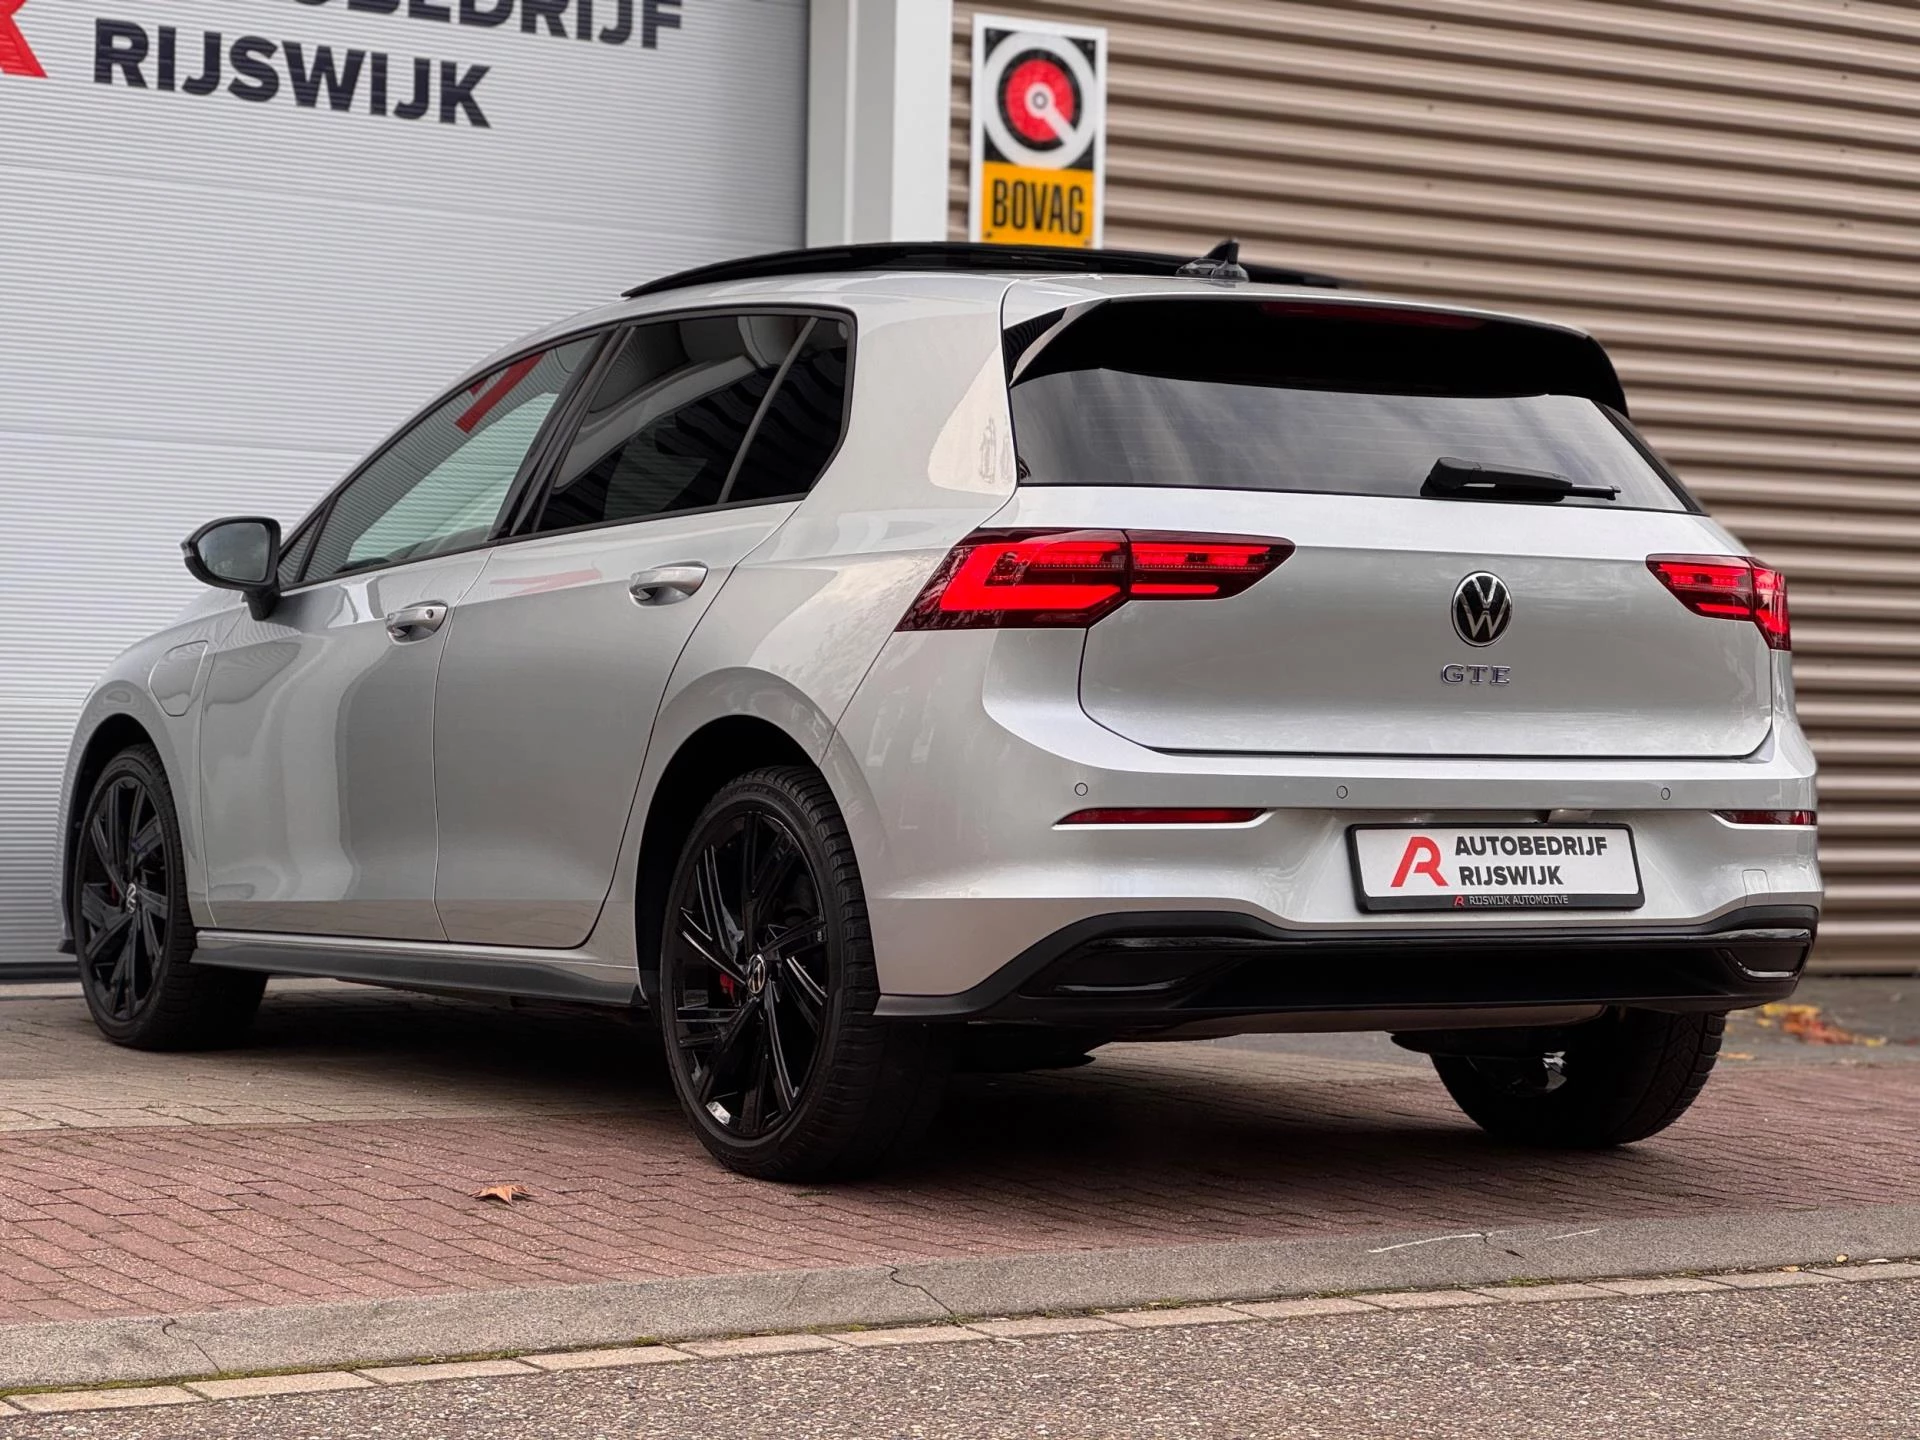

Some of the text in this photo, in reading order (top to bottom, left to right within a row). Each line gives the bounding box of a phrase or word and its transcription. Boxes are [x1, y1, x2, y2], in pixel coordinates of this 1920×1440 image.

[94, 18, 491, 128] RIJSWIJK
[991, 179, 1084, 235] BOVAG
[1441, 663, 1511, 684] GTE
[1455, 836, 1607, 856] AUTOBEDRIJF
[1459, 865, 1563, 886] RIJSWIJK
[1469, 895, 1510, 905] RIJSWIJK
[1512, 894, 1568, 905] AUTOMOTIVE
